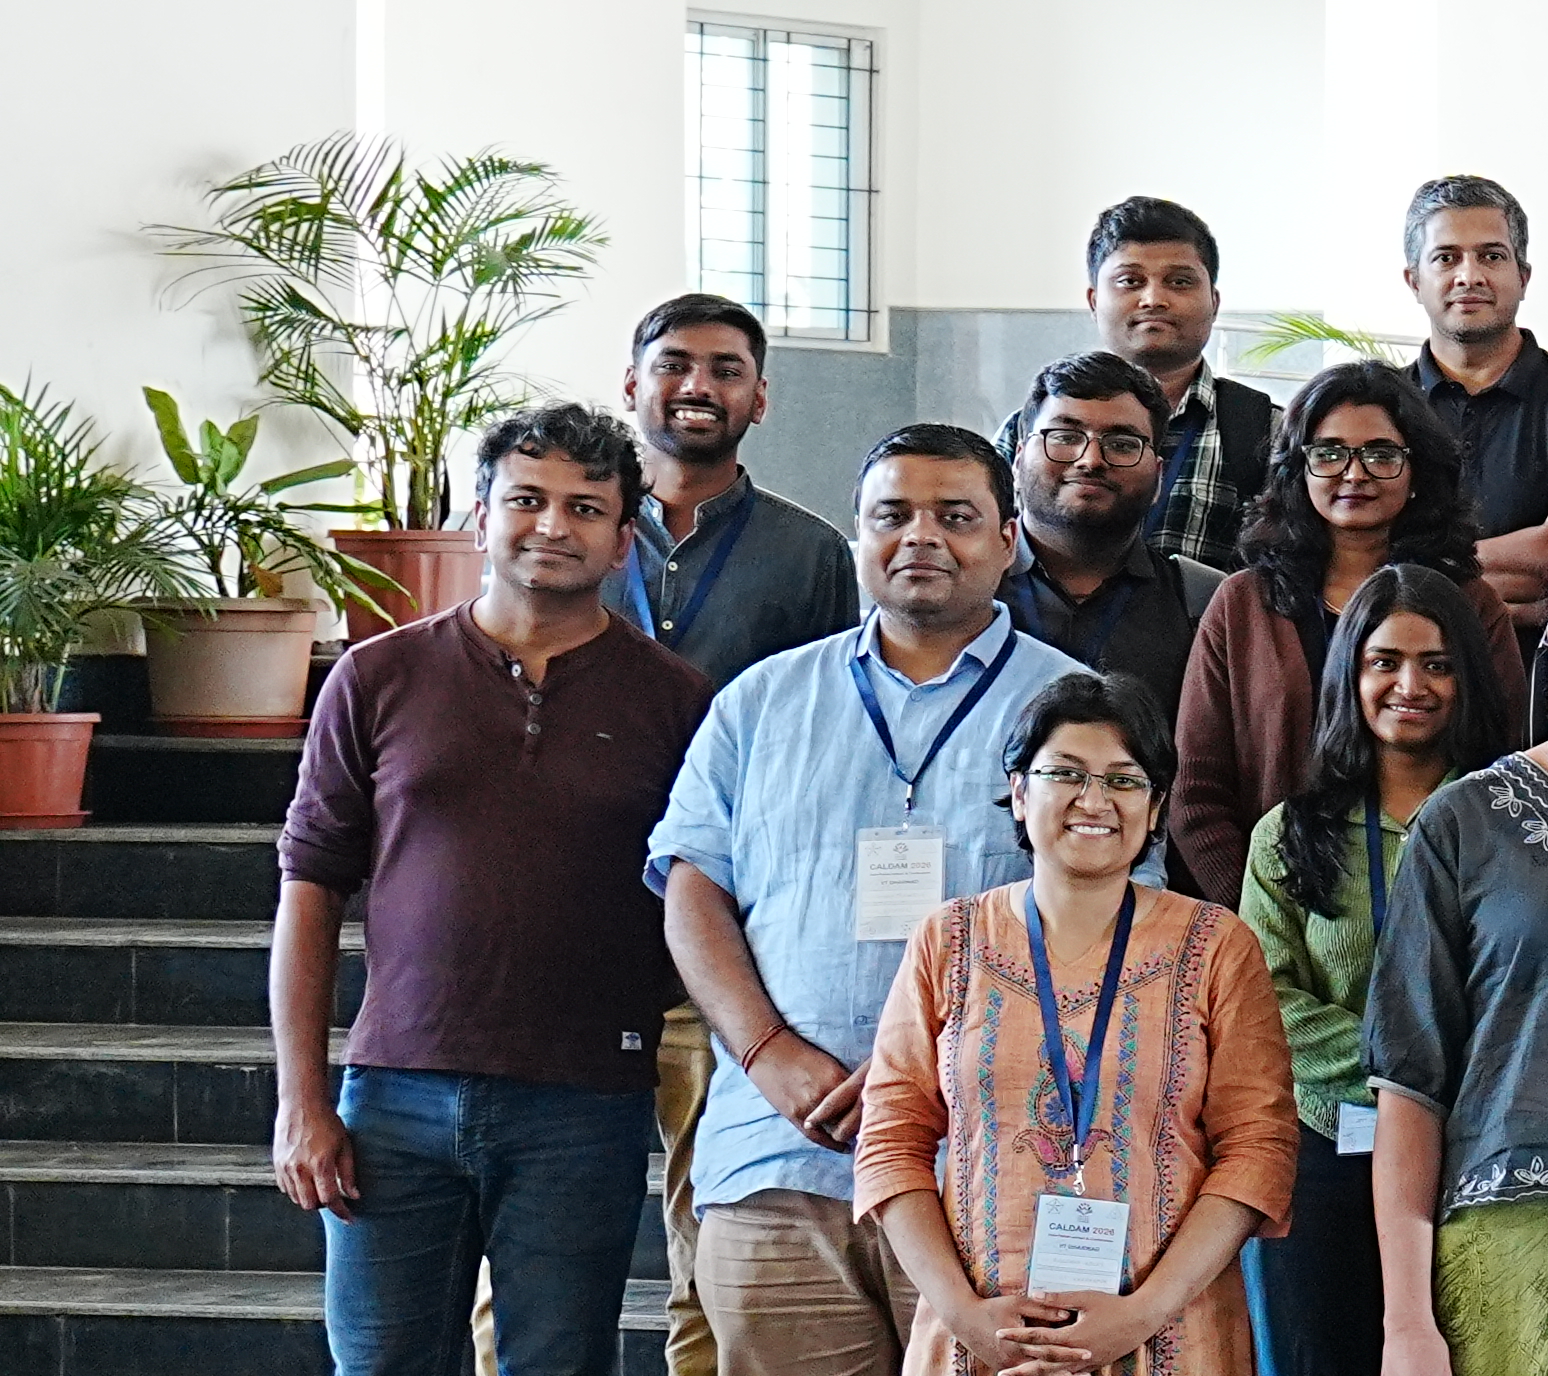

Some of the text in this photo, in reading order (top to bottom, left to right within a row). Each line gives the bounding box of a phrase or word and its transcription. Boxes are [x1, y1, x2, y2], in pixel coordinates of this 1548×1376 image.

[869, 862, 908, 871] CALDAM
[1049, 1222, 1115, 1236] CALDAM 2026
